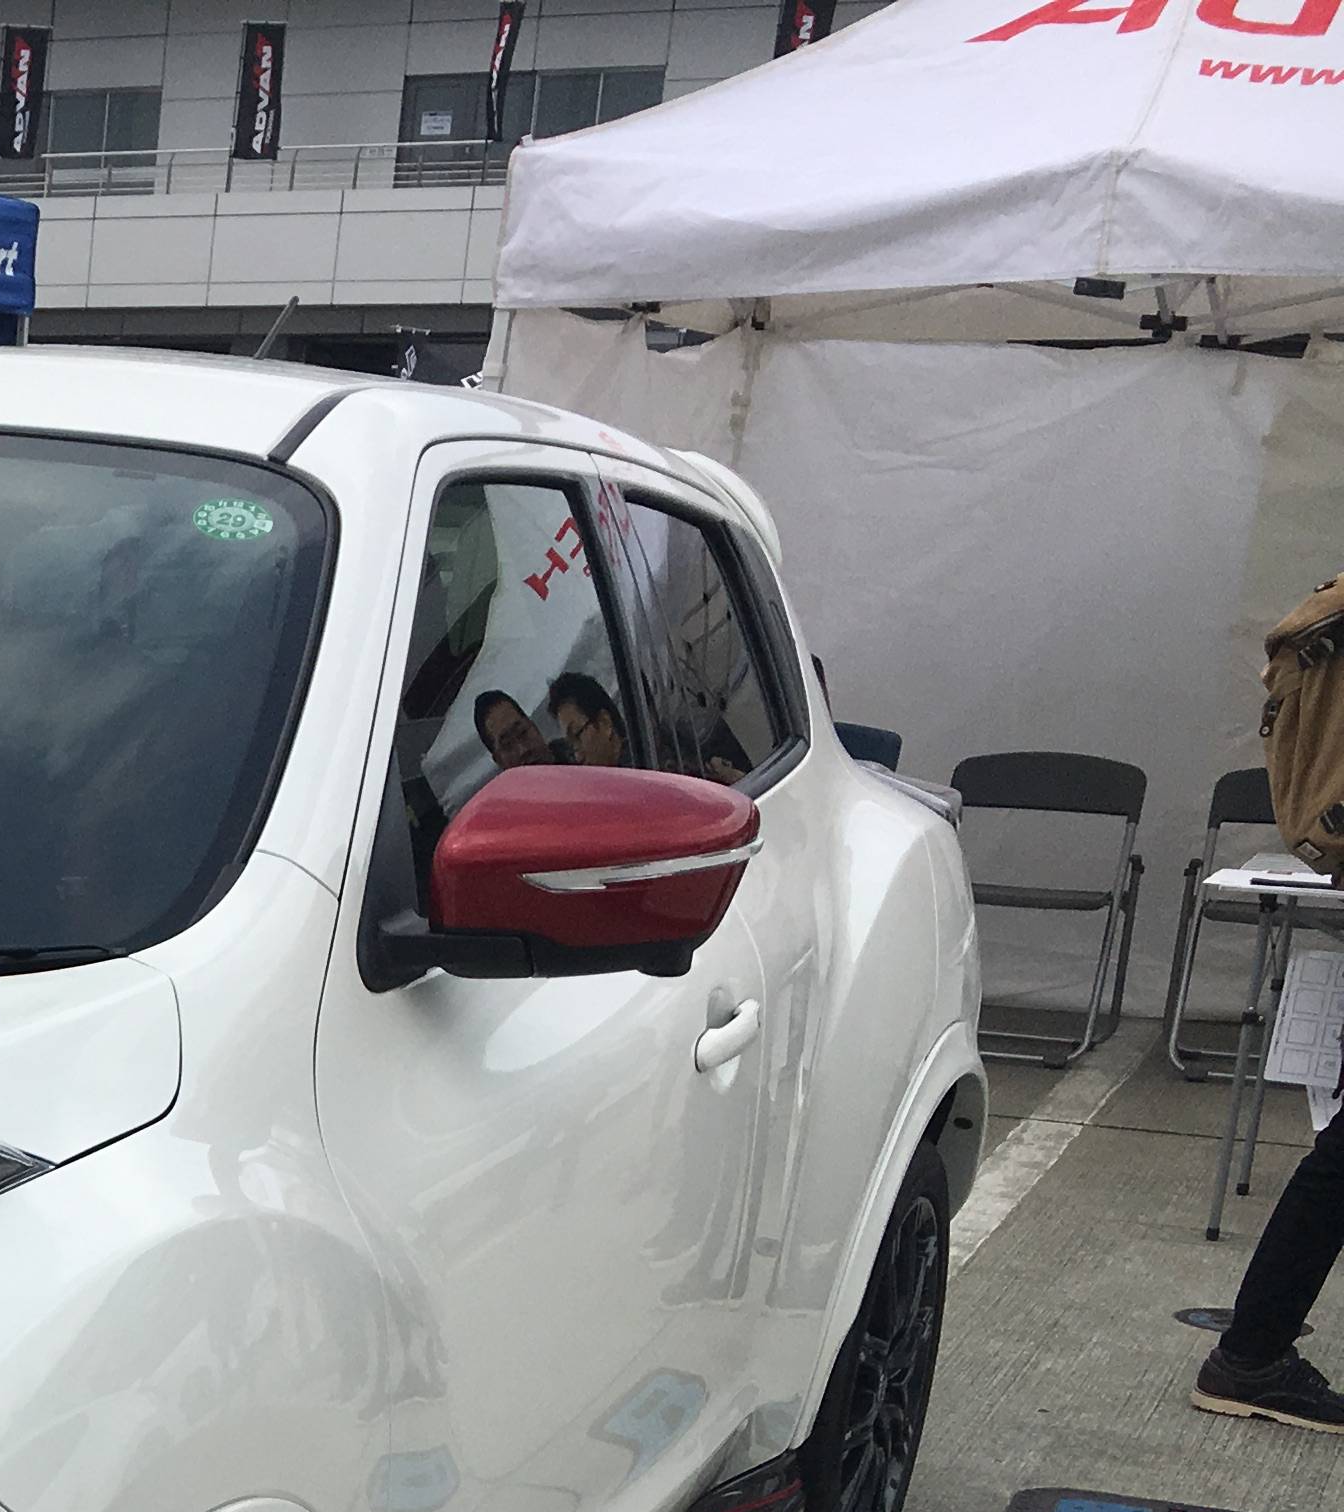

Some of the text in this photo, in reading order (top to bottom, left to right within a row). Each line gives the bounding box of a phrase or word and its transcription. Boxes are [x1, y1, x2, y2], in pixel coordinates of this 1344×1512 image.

[13, 48, 31, 153] ADVAN
[252, 45, 272, 154] ADVAN
[216, 512, 247, 528] 29
